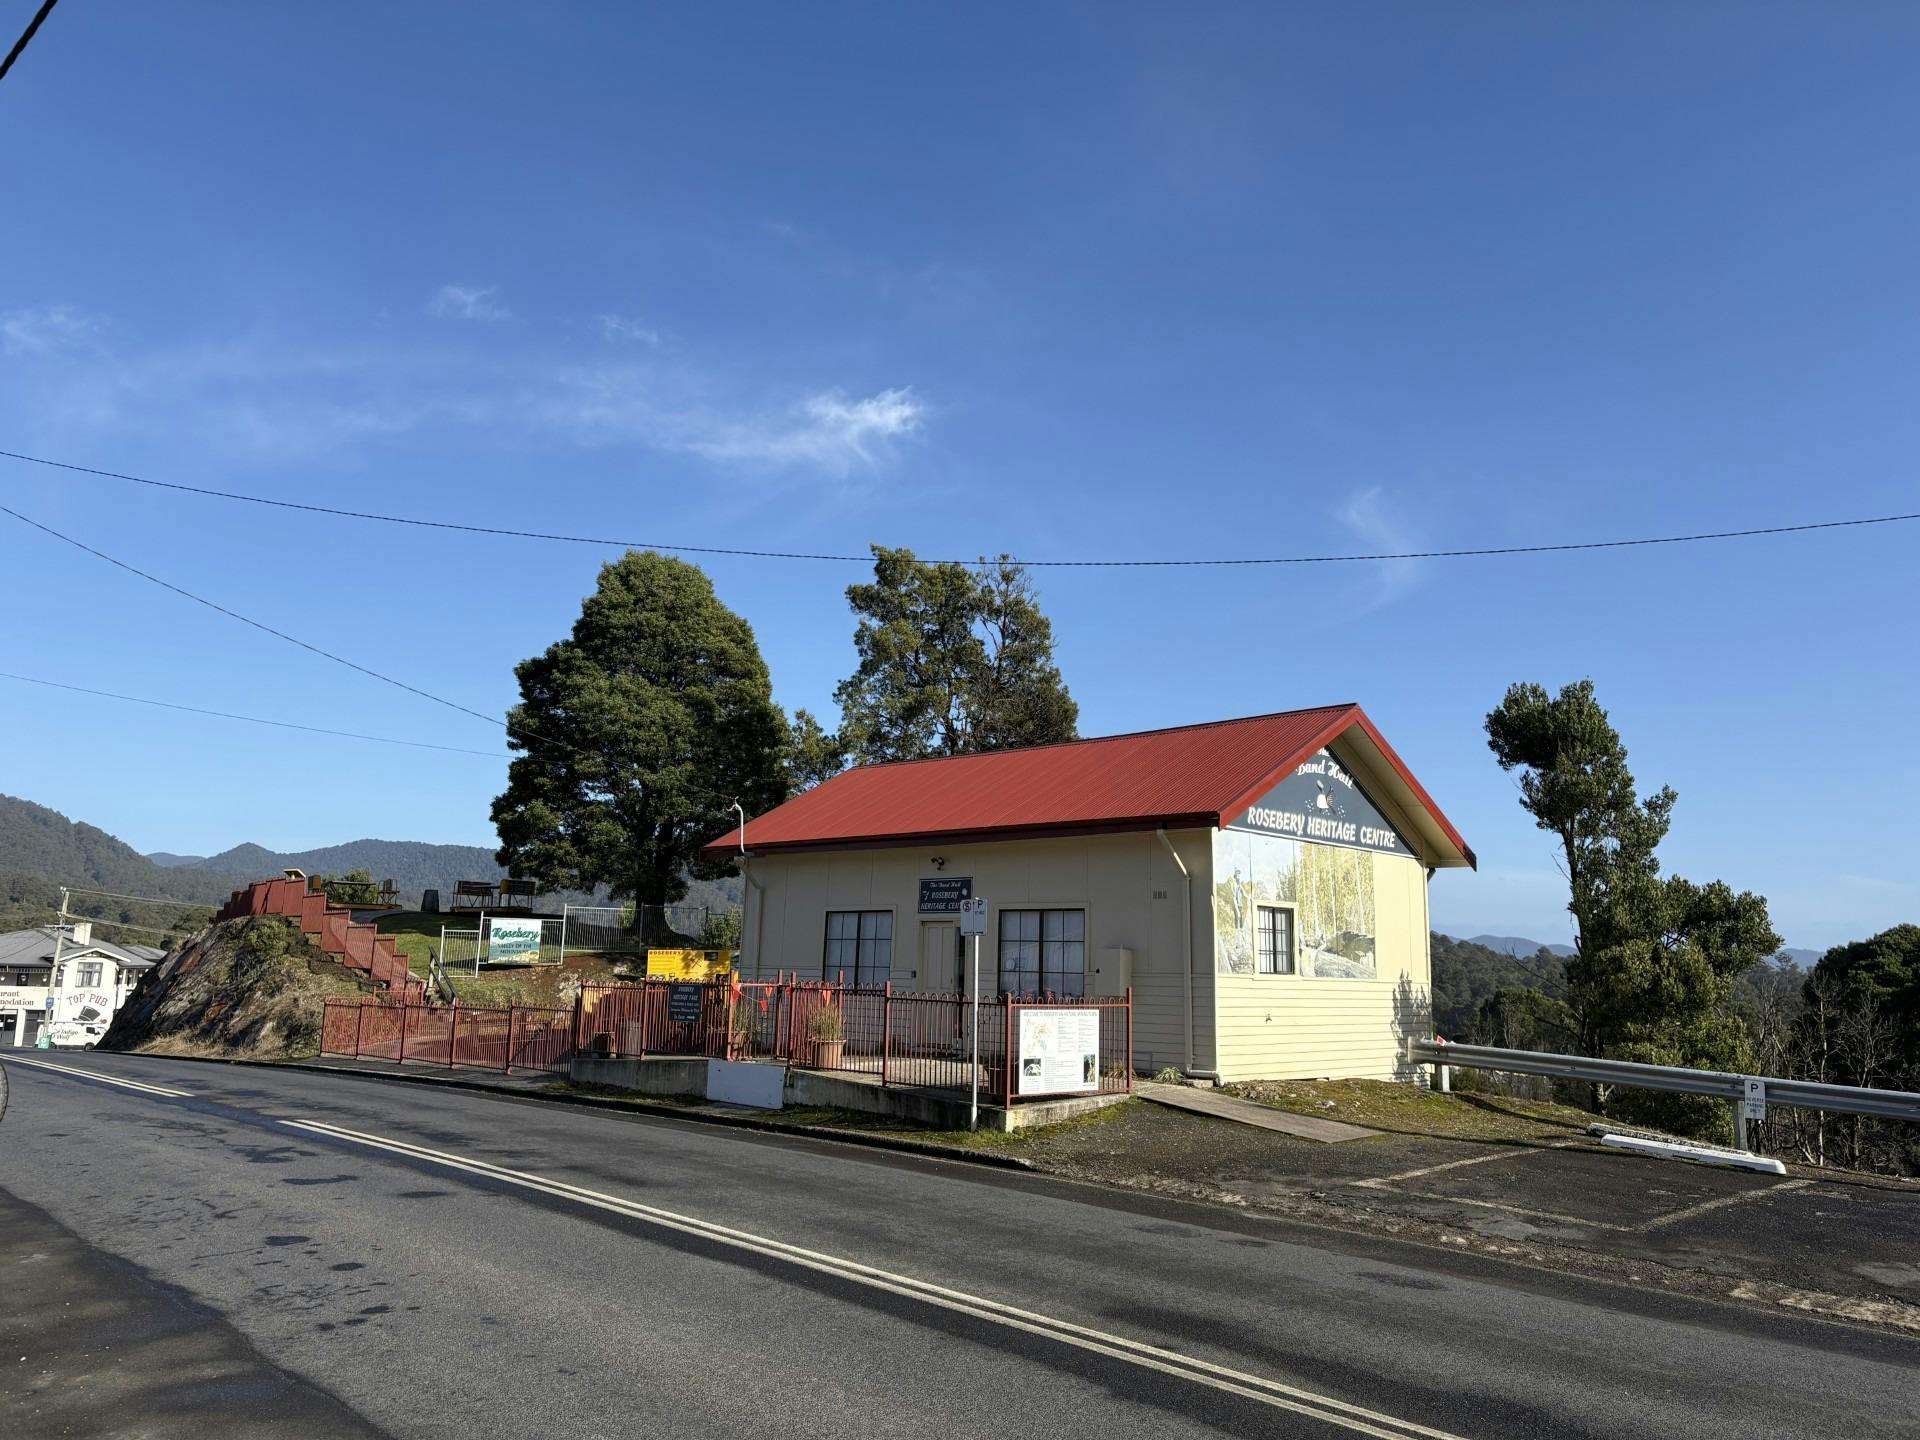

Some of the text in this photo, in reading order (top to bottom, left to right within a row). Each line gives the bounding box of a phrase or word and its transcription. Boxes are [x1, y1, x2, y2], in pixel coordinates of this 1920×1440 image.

[1247, 807, 1395, 848] ROSEBERY HERITAGE CENTRE
[932, 891, 958, 899] ROSEBERY
[921, 902, 946, 910] HERITAGE
[978, 900, 983, 909] P
[492, 927, 540, 941] Rosebery
[66, 993, 85, 1005] TOP
[89, 993, 108, 1006] PUB
[1751, 1083, 1758, 1092] P
